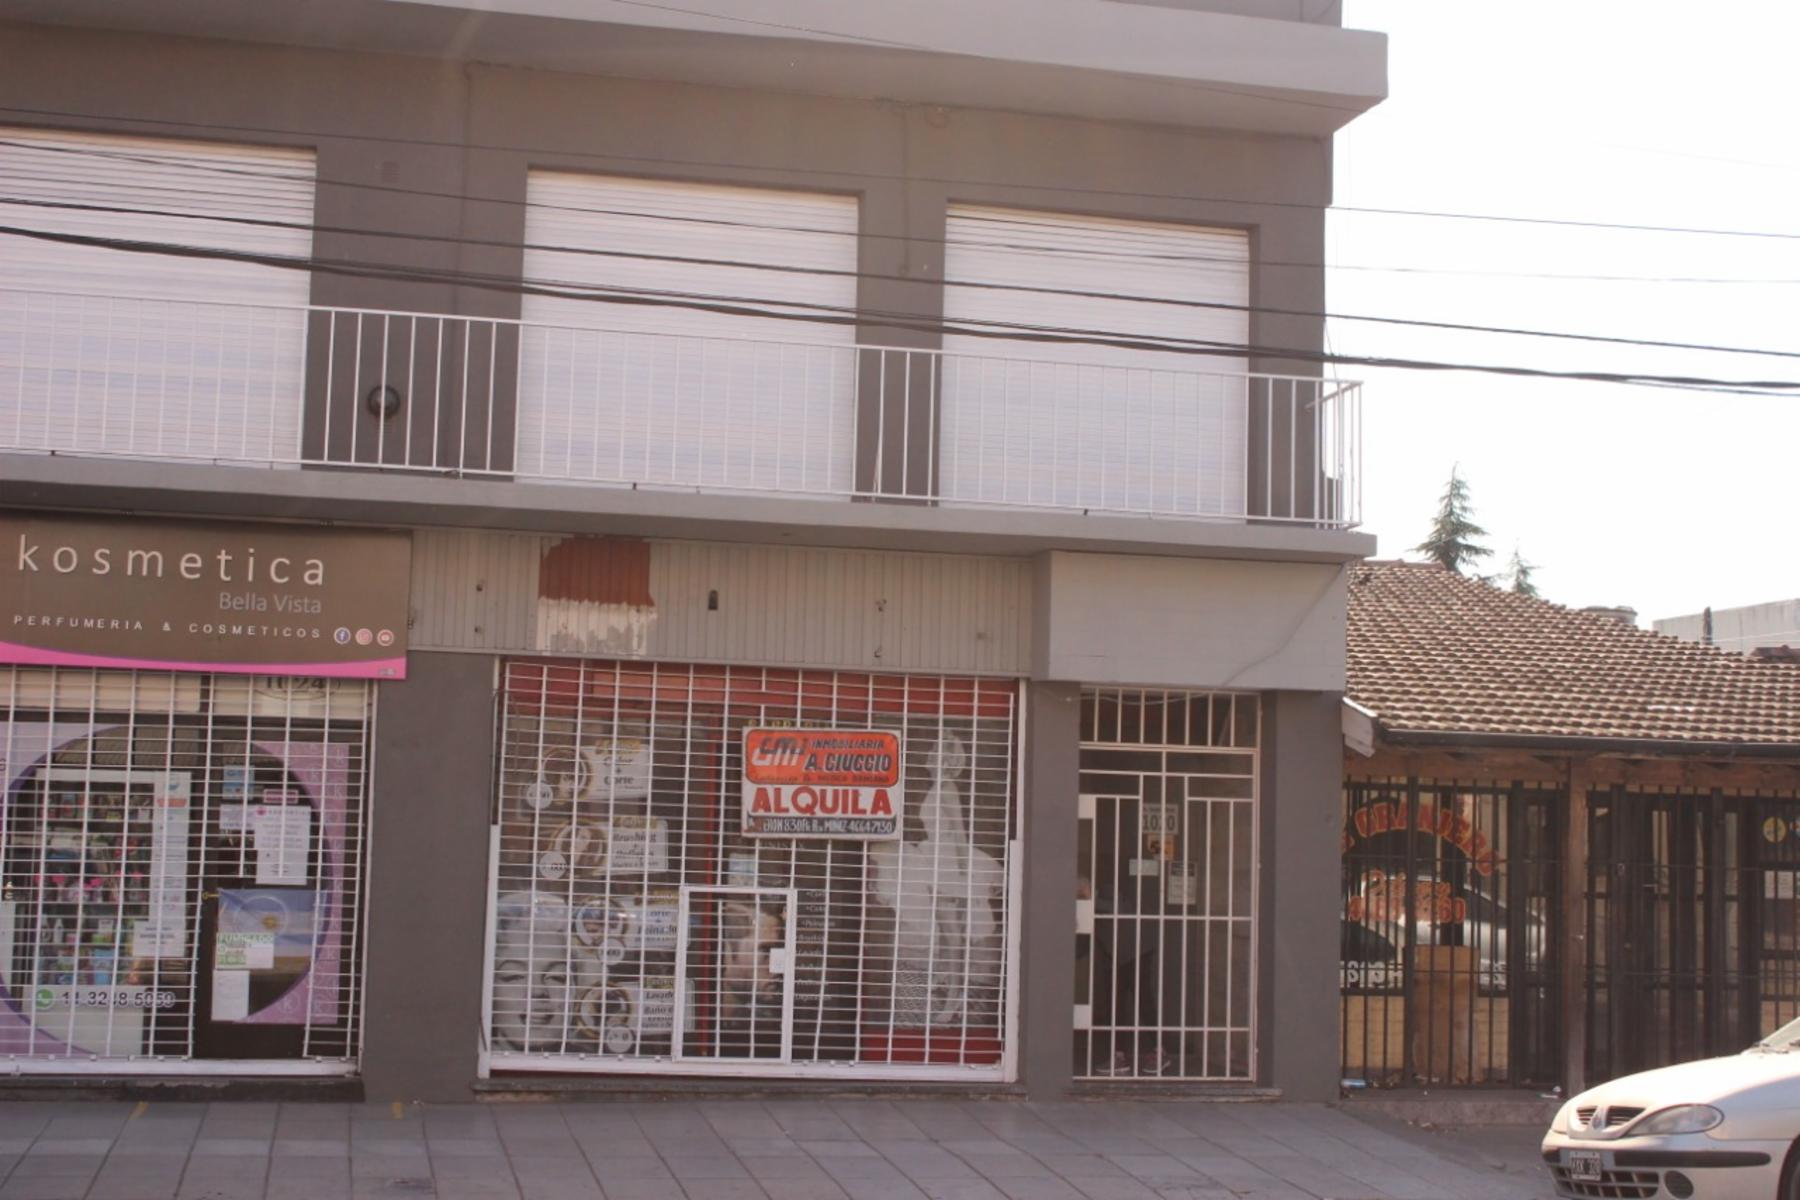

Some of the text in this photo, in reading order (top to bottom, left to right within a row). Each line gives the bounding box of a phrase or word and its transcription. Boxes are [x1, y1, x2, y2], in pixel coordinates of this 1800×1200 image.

[17, 534, 325, 586] kosmetica
[219, 592, 323, 614] Bella Vista
[13, 615, 321, 638] PERFUMERIA & COSMETICOS
[751, 786, 893, 816] ALQUILA
